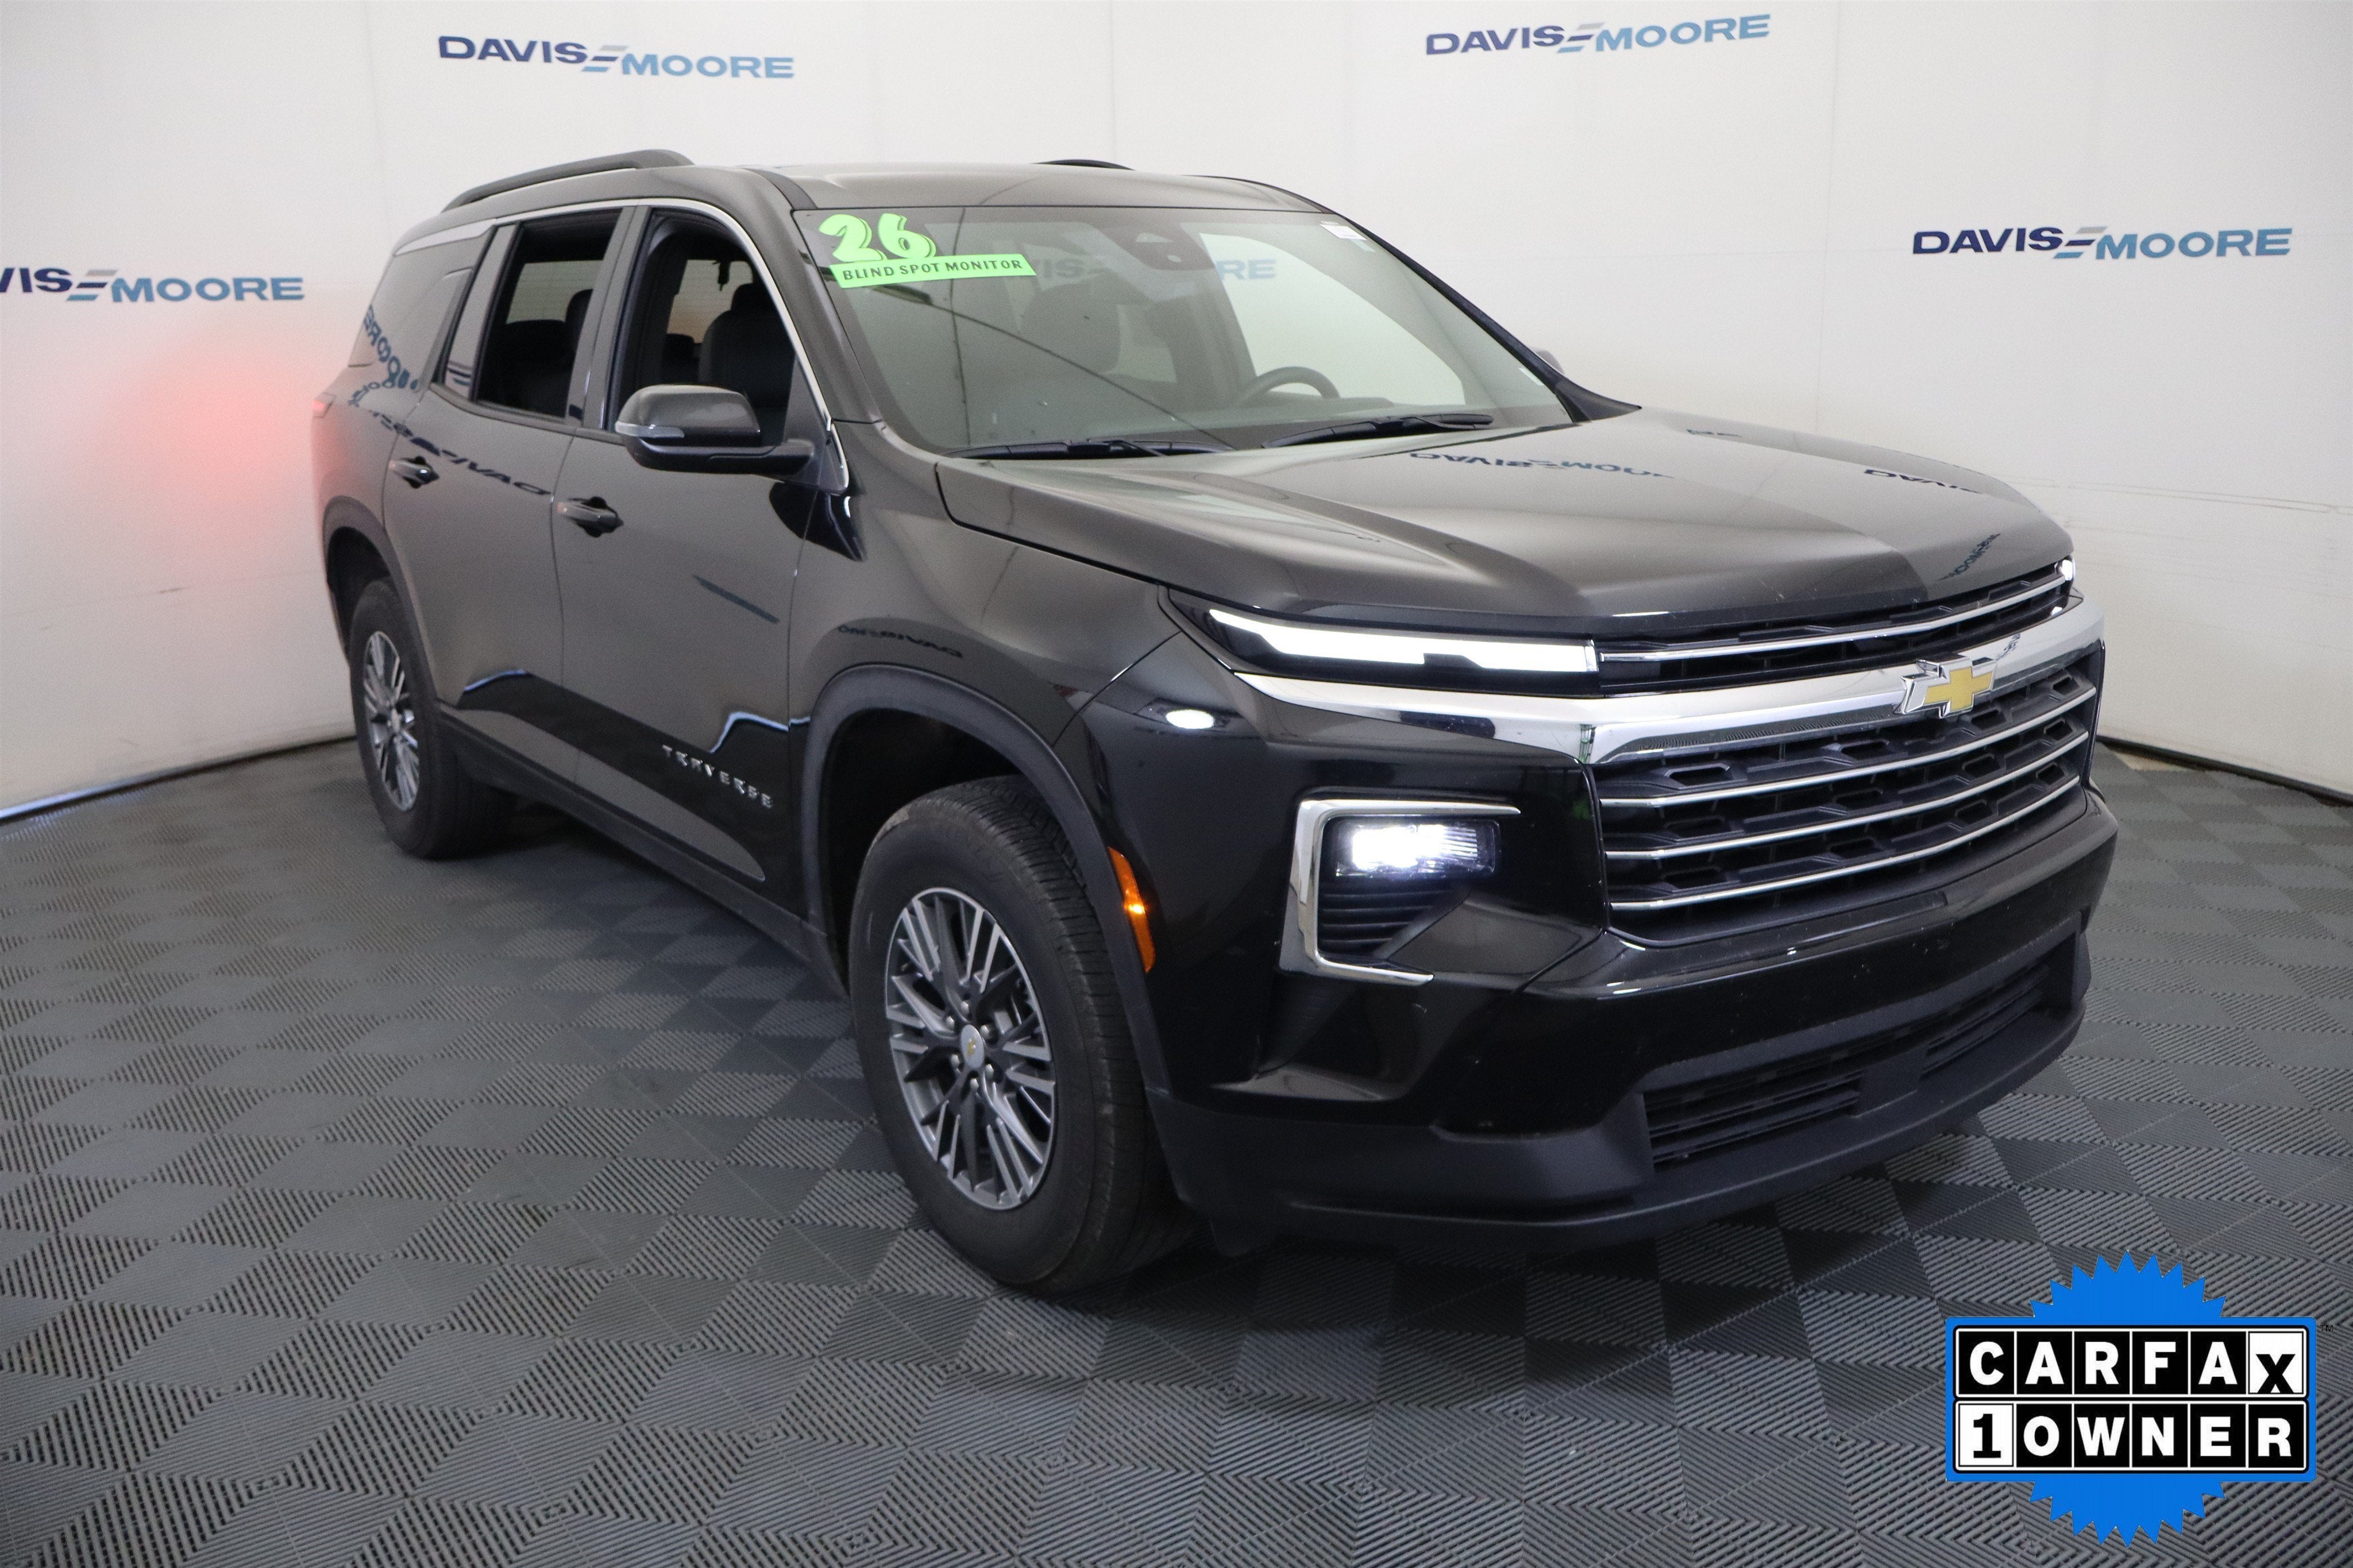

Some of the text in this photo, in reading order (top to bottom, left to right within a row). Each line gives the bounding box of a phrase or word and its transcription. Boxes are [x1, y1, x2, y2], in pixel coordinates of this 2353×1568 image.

[1426, 14, 1770, 55] DAVIS MOORE
[438, 35, 795, 79] DAVIS MOORE
[819, 213, 936, 262] 26
[1912, 226, 2293, 260] DAVIS MOORE
[111, 276, 306, 303] MOORE
[843, 266, 895, 280] BLIND
[899, 262, 940, 275] SPOT
[945, 259, 1024, 272] MONITOR
[662, 744, 774, 809] TRAVERSE
